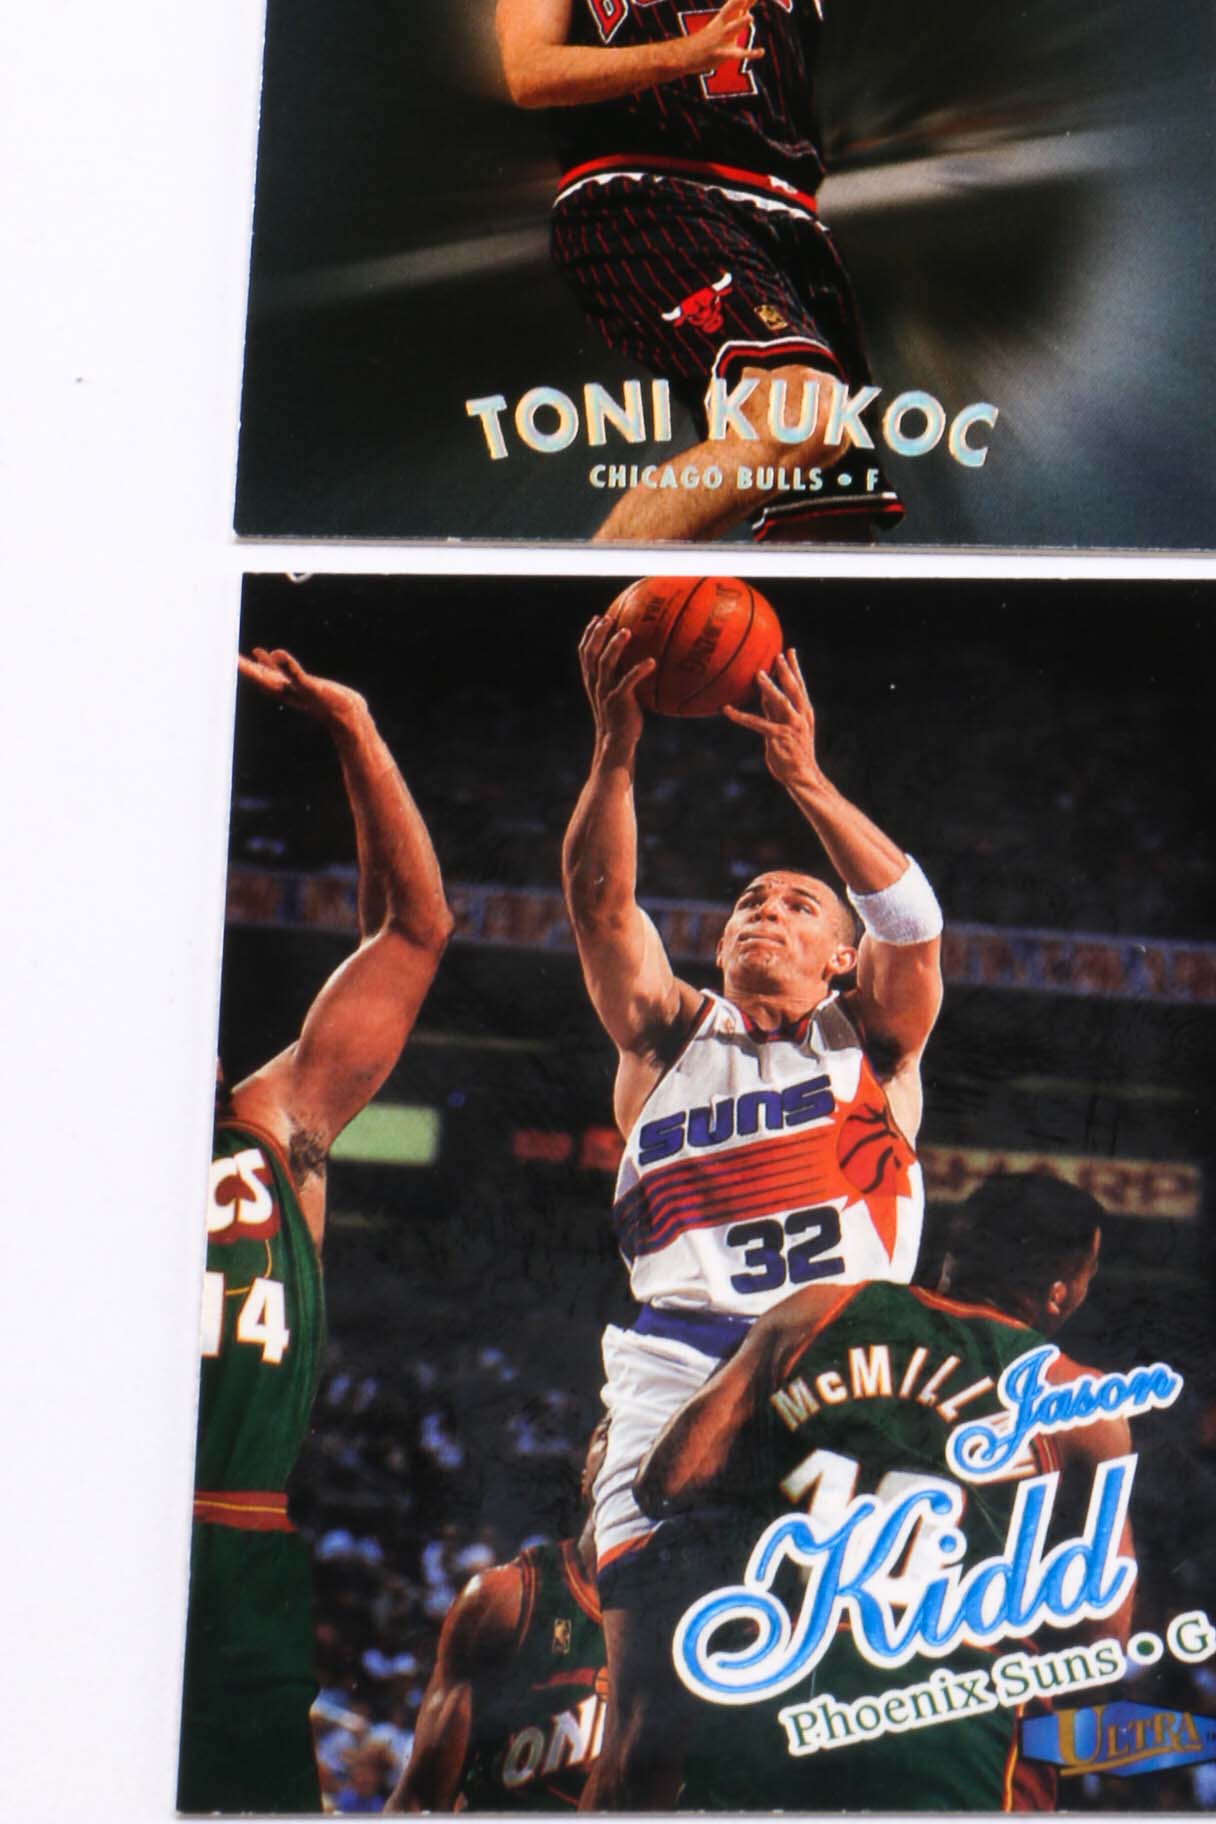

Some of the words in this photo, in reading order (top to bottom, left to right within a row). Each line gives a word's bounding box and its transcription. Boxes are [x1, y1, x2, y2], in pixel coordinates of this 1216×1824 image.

[466, 379, 673, 460] TONI
[704, 378, 999, 468] KUKOC
[589, 463, 723, 490] CHICAGO
[736, 467, 825, 491] BULLS
[866, 468, 879, 491] F
[638, 1074, 836, 1167] SUNS
[726, 1205, 846, 1295] 32
[201, 1270, 291, 1366] 14
[950, 1345, 1181, 1478] Jason
[679, 1460, 1132, 1698] Kidd
[787, 1669, 988, 1750] Phoenix
[999, 1640, 1121, 1698] Suns
[1175, 1618, 1211, 1655] G
[1055, 1704, 1203, 1774] ULTRA
